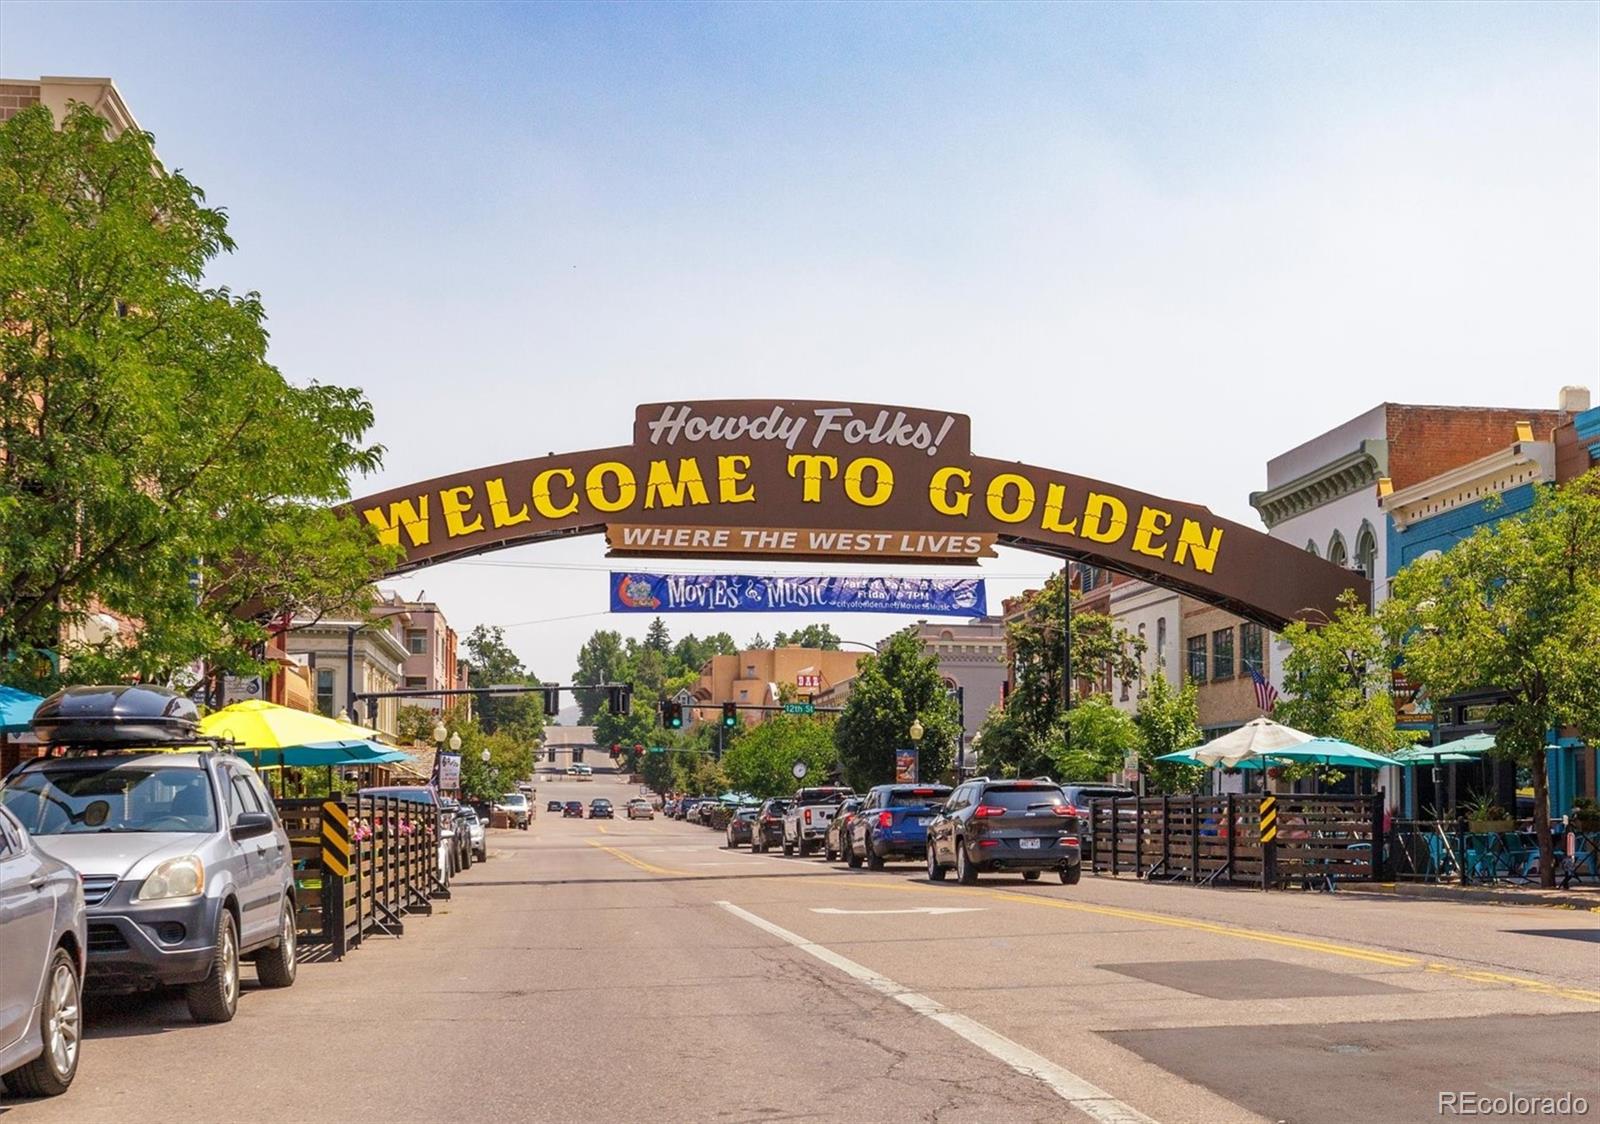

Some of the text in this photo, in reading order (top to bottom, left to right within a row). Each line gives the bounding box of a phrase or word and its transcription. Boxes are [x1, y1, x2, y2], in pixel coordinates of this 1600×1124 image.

[648, 405, 955, 456] Howdy Folks!
[363, 455, 1223, 574] WELCOME TO GOLDEN
[623, 527, 982, 554] WHERE THE WEST LIVES
[857, 590, 890, 600] Friday
[906, 591, 930, 601] 7PM
[786, 705, 814, 713] 12th St
